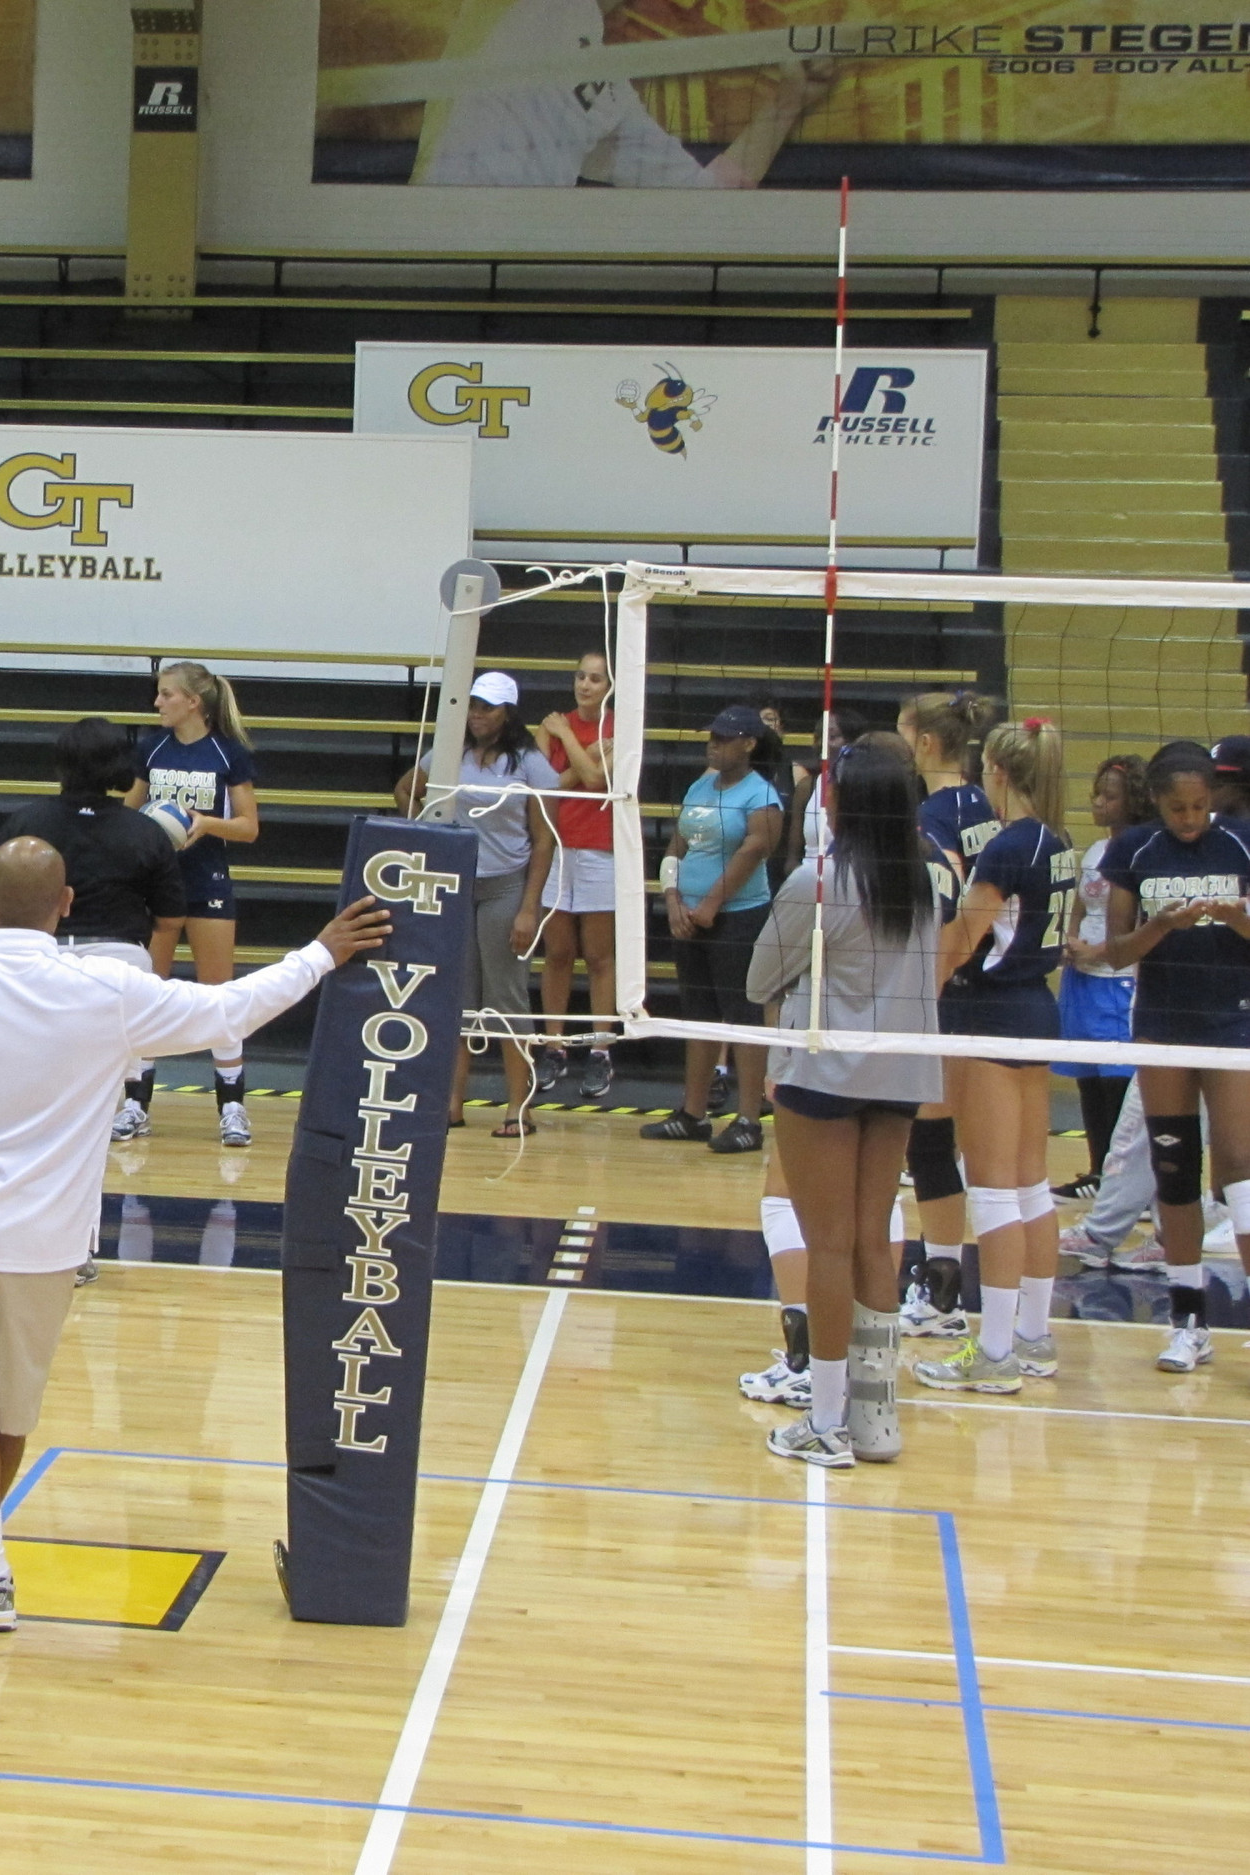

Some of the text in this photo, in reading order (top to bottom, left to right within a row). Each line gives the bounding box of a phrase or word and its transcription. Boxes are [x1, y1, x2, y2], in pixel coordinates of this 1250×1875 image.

[788, 24, 1003, 53] ULRIKE
[987, 59, 1075, 74] 2006
[1092, 59, 1179, 74] 2007
[138, 105, 193, 115] RUSSELL
[407, 361, 531, 438] GT
[815, 415, 937, 434] RUSSELL
[812, 434, 934, 446] AHLETIC
[149, 768, 217, 788] GEORGIA
[149, 784, 217, 811] TECH
[363, 850, 460, 916] GT
[1140, 874, 1240, 898] GEORGIA
[331, 959, 437, 1455] VOLLEYBALL
